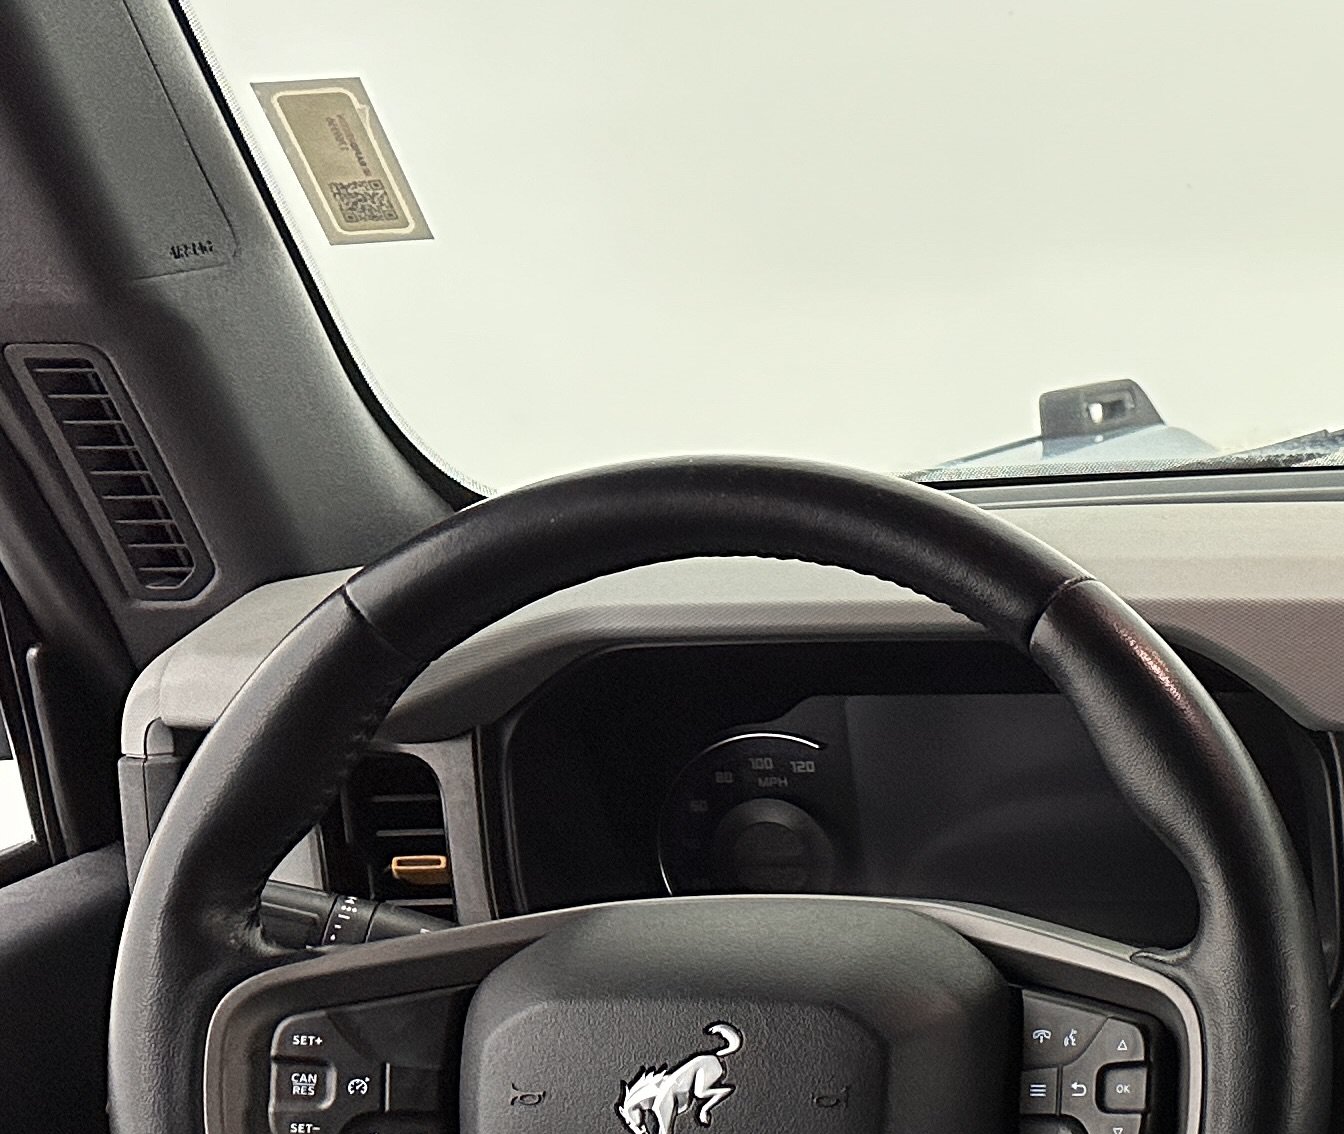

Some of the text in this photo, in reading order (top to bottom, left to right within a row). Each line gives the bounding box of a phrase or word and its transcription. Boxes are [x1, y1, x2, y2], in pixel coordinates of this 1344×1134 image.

[748, 757, 774, 770] 100
[790, 760, 816, 773] 120
[757, 776, 789, 788] MPH
[292, 1034, 323, 1046] SET+
[291, 1073, 317, 1084] CAN
[292, 1085, 316, 1096] RES
[1115, 1084, 1131, 1094] OK
